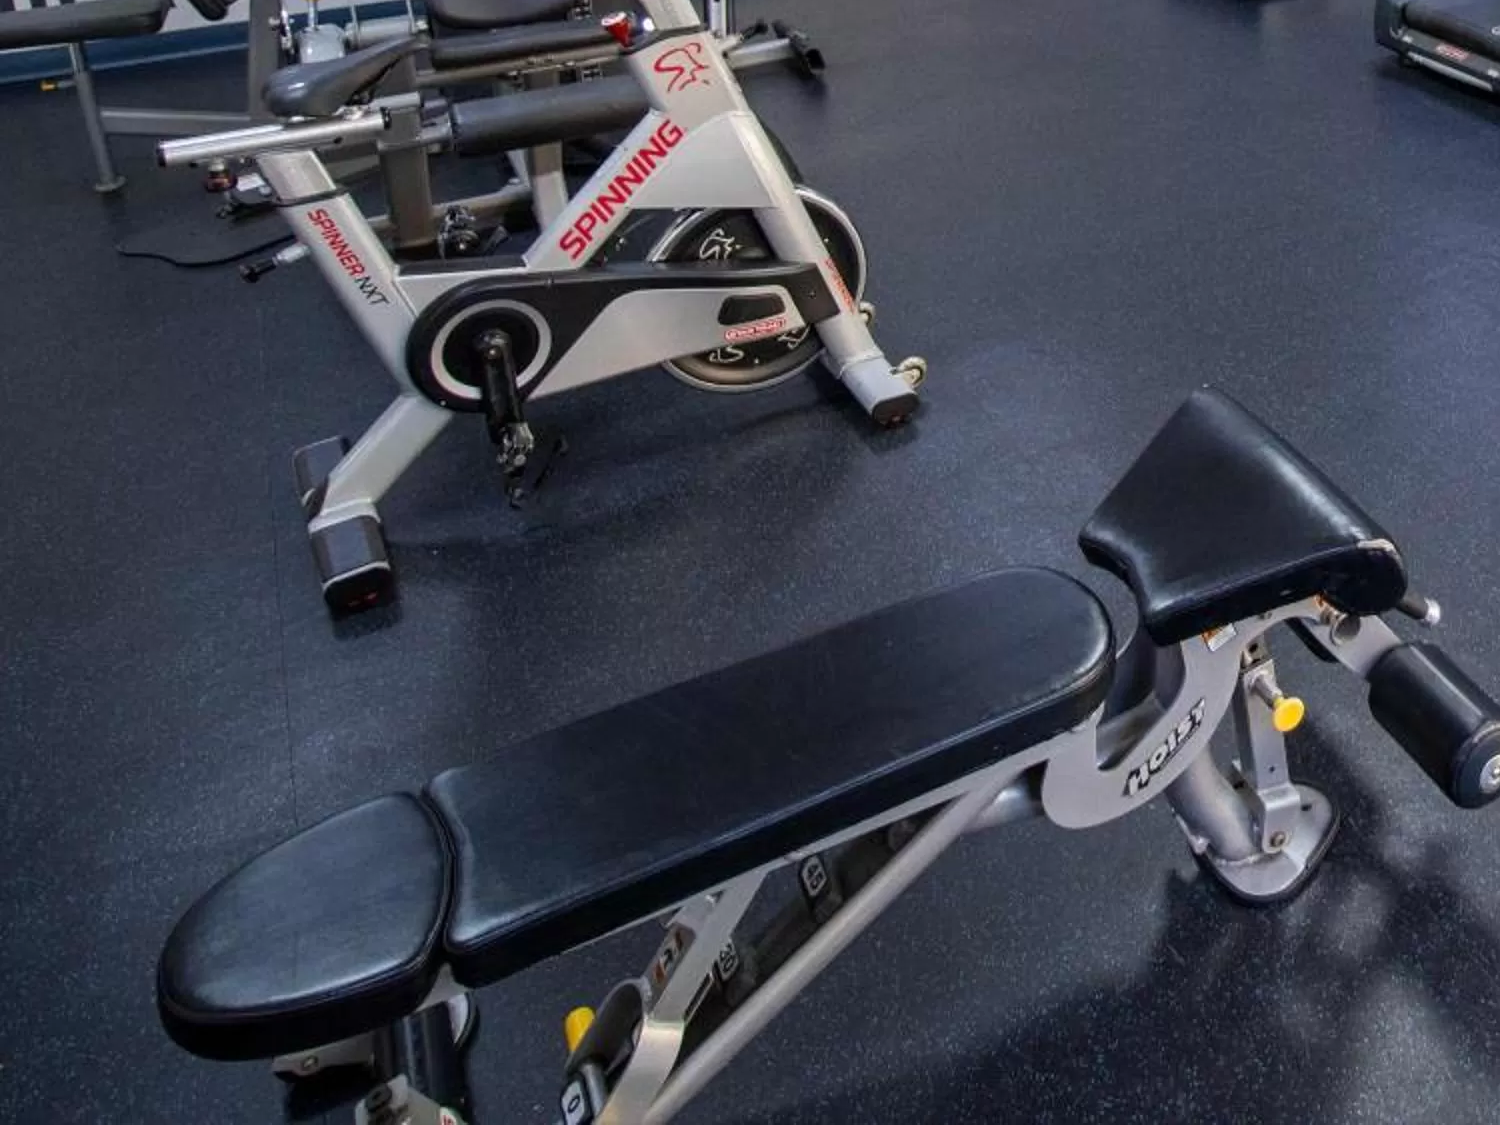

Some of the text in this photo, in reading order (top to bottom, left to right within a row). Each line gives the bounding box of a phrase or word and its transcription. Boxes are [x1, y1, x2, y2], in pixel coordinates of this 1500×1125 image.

[558, 119, 685, 262] SPINNING
[307, 207, 391, 307] SPINNER NXT
[1123, 698, 1206, 796] HOIST
